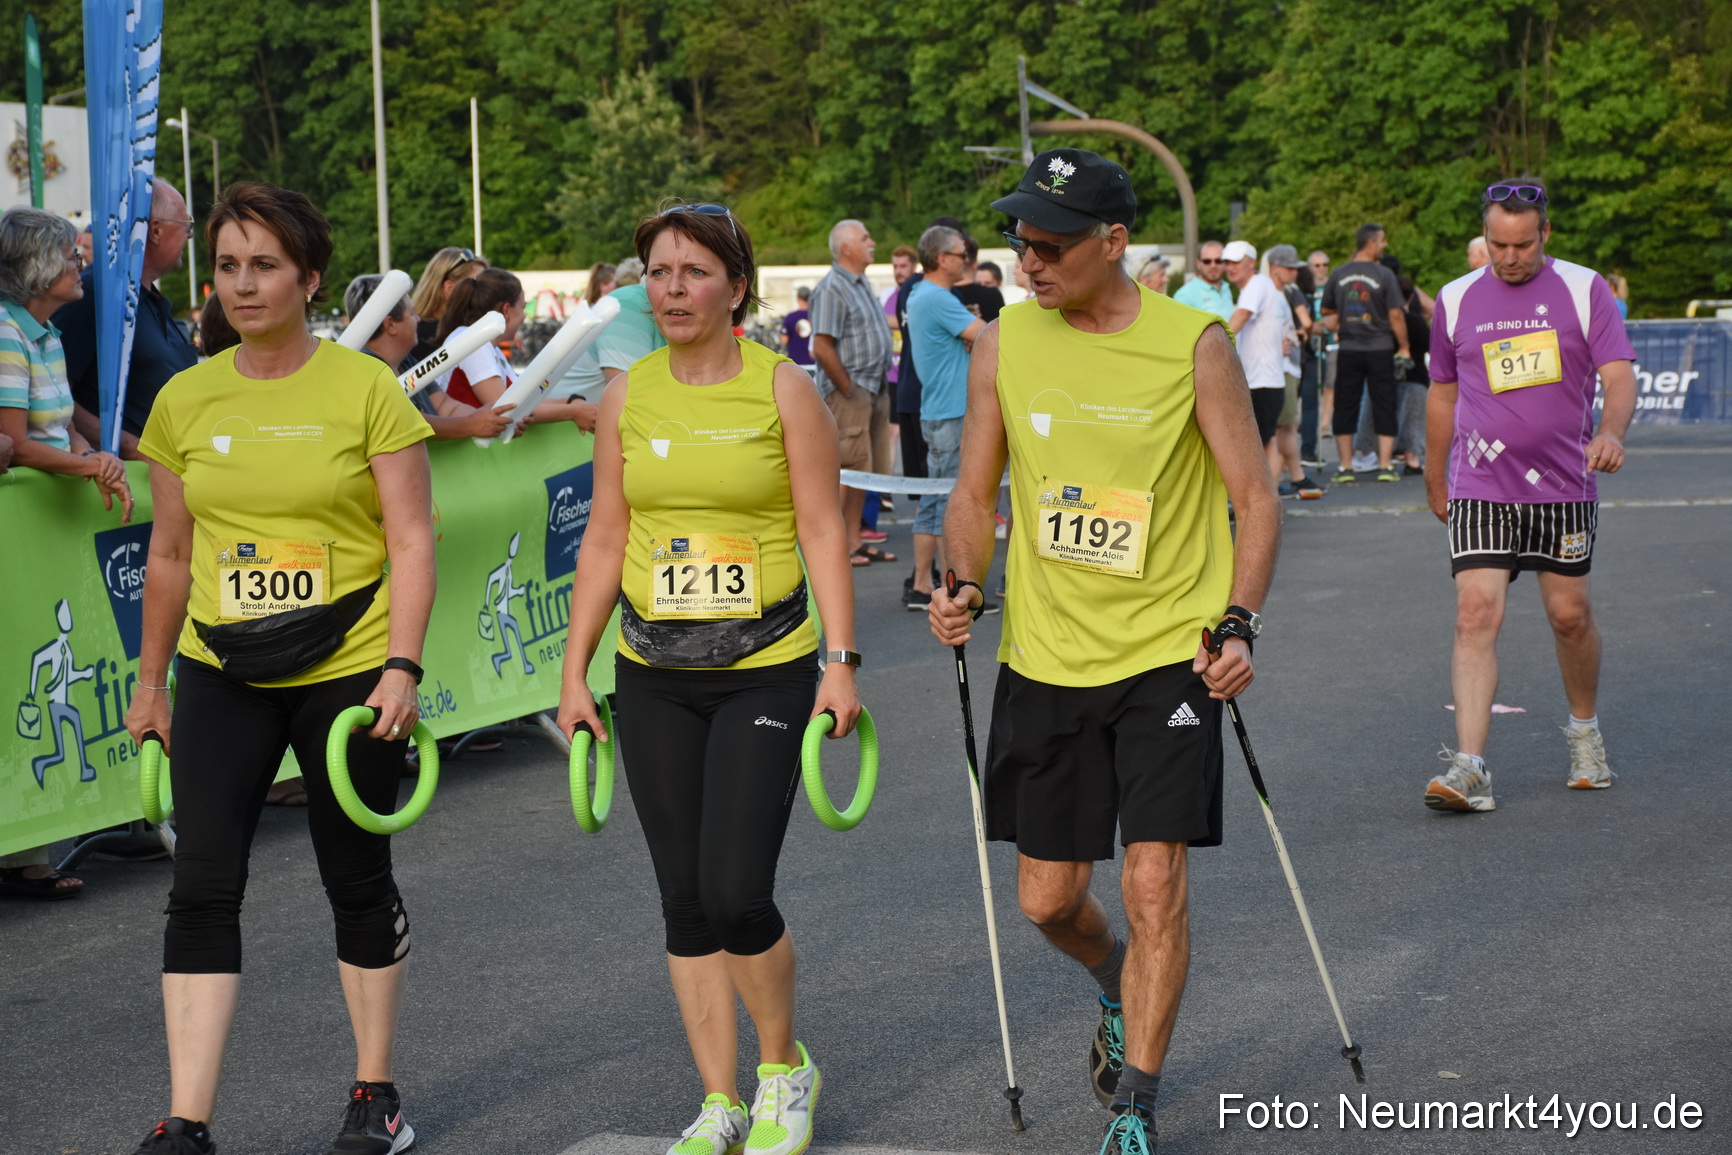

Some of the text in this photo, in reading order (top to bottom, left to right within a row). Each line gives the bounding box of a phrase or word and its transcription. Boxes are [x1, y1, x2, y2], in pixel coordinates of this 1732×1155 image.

[1476, 320, 1552, 333] WIR SIND LILA.
[1501, 352, 1542, 376] 917
[1080, 403, 1105, 411] Kliniken
[1118, 406, 1153, 414] Landkreises
[1097, 412, 1128, 421] Neumarkt
[1052, 497, 1098, 510] firmenlauf
[557, 499, 592, 525] Fischer
[1100, 509, 1143, 521] walk 2019
[1048, 512, 1132, 552] 1192
[663, 550, 707, 559] firmenlauf
[1050, 543, 1124, 560] Achhammer Alois
[230, 556, 273, 565] firmenlauf
[711, 553, 732, 563] walk
[1059, 554, 1083, 562] Klinikum
[1084, 558, 1112, 566] Neumarkt
[278, 560, 300, 569] walk
[228, 570, 313, 601] 1300
[662, 564, 745, 595] 1213
[130, 589, 144, 602] AUT
[656, 596, 752, 606] Ehrnsberger Jaennette
[240, 602, 301, 610] Strobl Andrea
[1168, 717, 1200, 727] adidas
